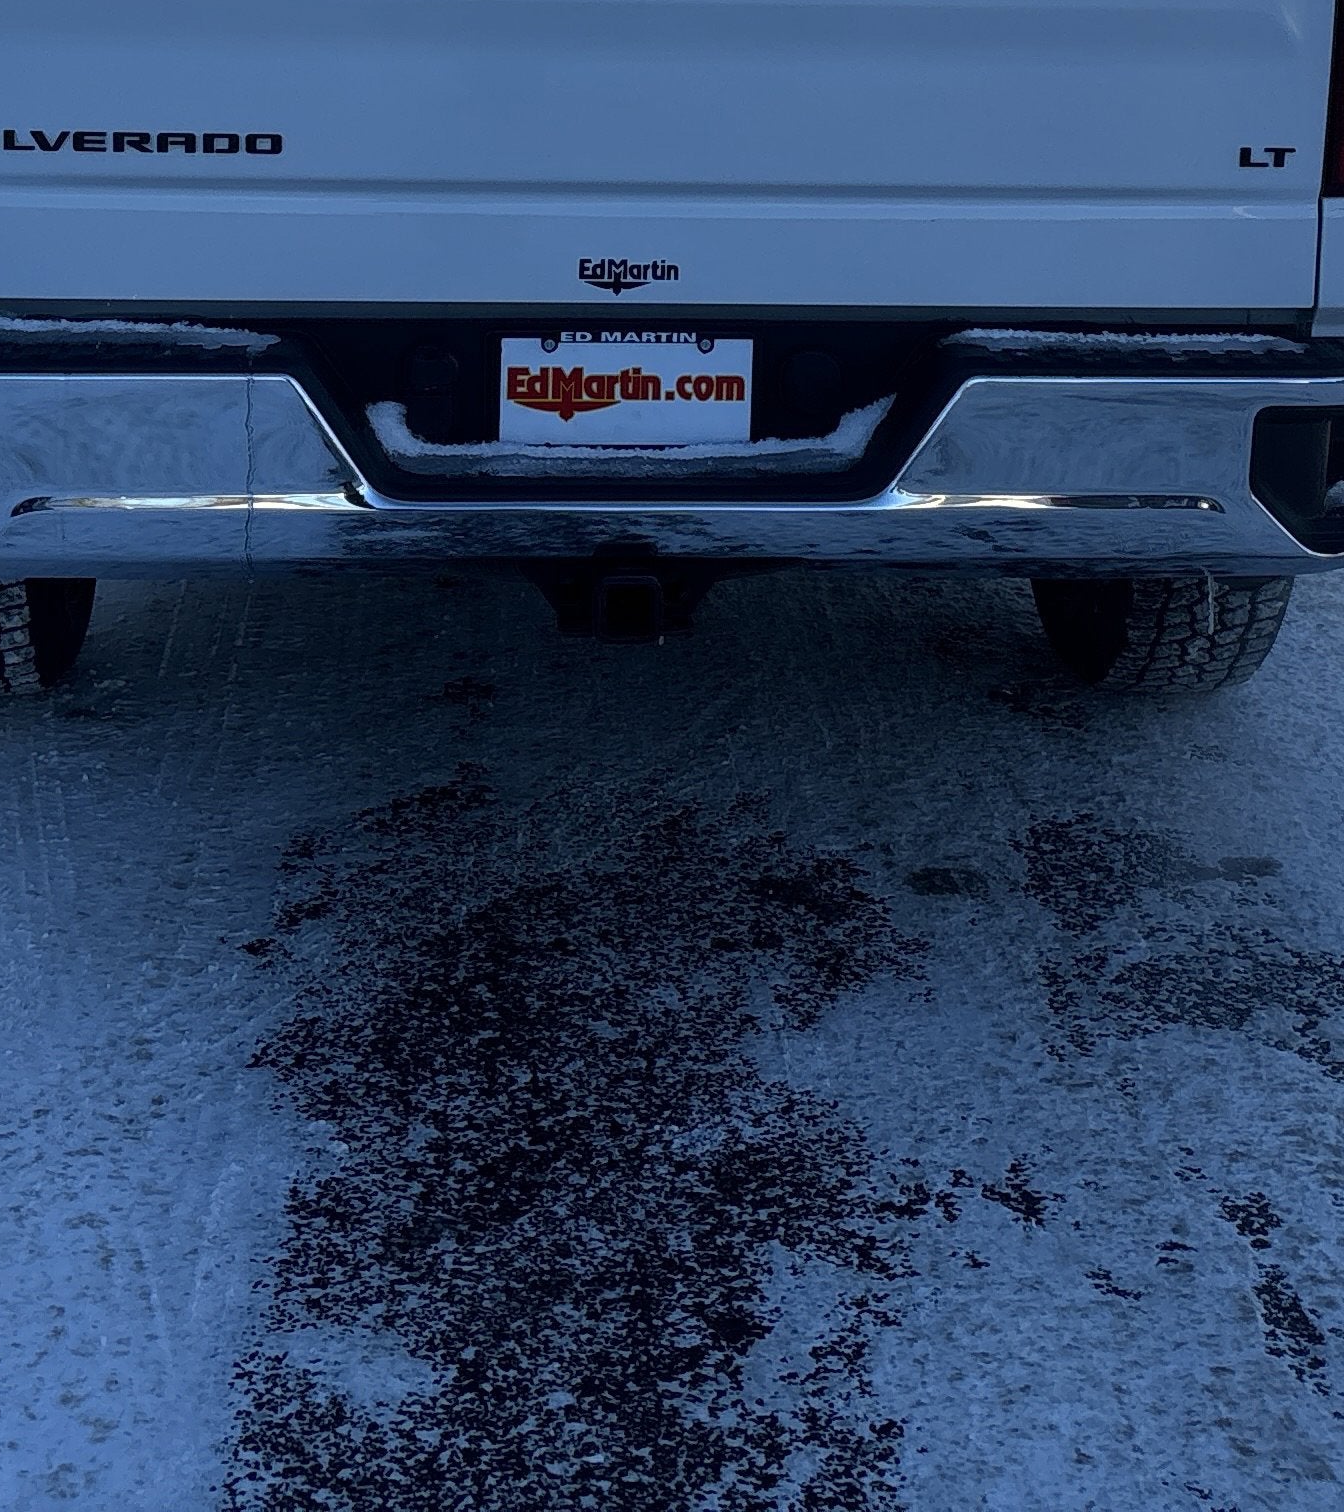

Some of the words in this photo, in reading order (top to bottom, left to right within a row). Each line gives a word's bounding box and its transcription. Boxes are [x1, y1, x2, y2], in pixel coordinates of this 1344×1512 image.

[1238, 146, 1297, 168] LT
[560, 331, 593, 343] ED
[600, 331, 697, 343] MARTIN
